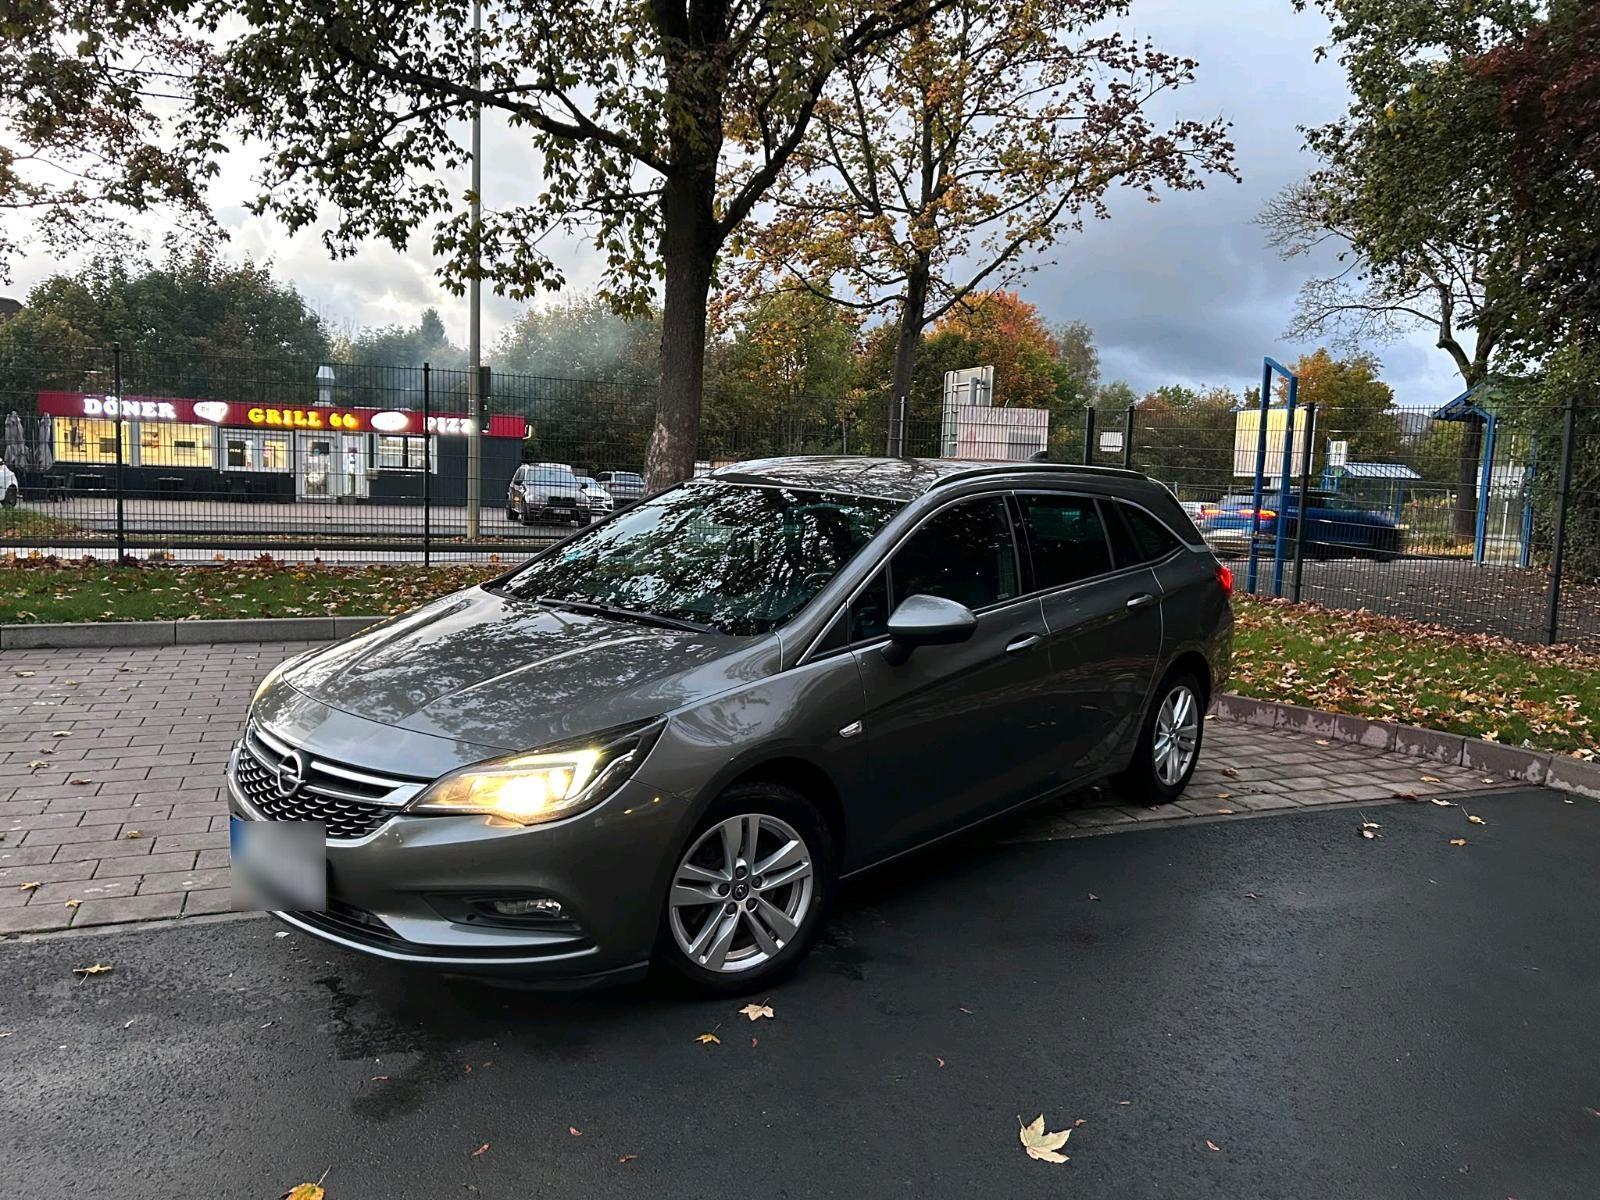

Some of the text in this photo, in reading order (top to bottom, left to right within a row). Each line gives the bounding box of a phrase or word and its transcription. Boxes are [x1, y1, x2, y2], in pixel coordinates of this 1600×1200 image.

[83, 396, 177, 418] DÖNER
[247, 407, 321, 427] GRILL
[329, 412, 357, 429] 66
[423, 416, 489, 433] PIZZ
